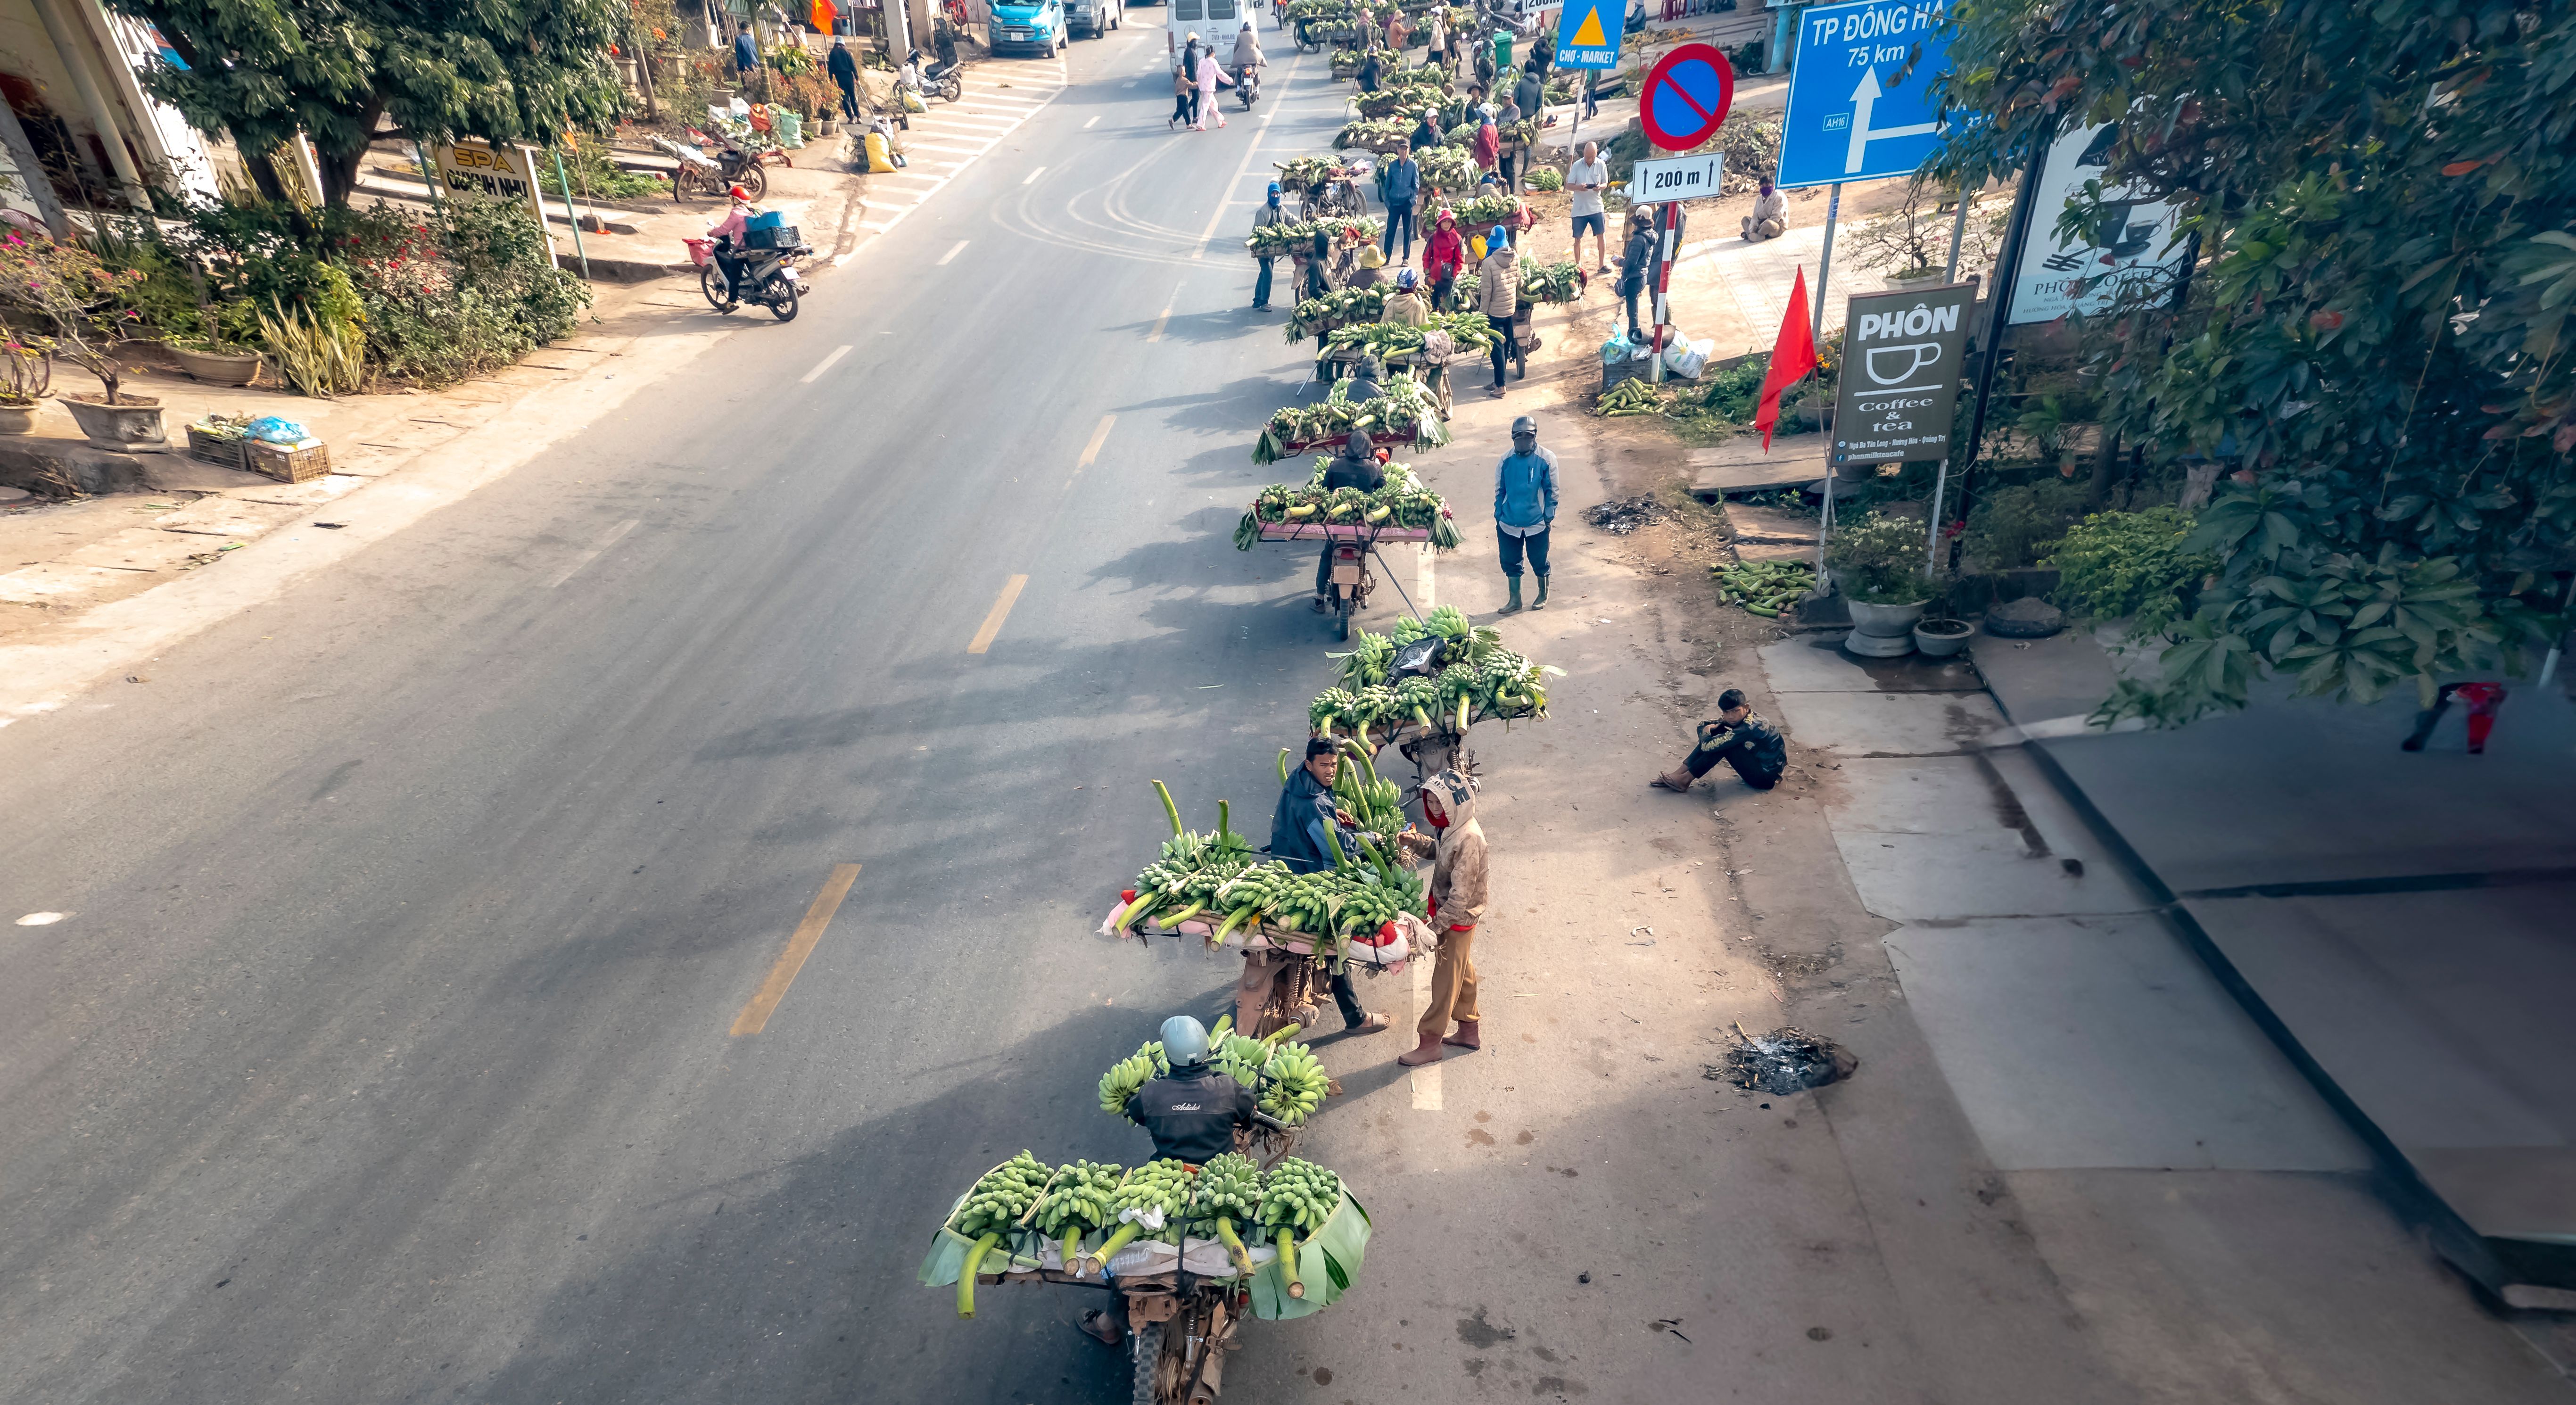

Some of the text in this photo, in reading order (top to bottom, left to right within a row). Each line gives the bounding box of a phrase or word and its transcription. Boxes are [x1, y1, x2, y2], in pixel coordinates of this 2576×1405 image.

[1812, 17, 1839, 46] TP
[1843, 4, 1908, 42] ĐÔNG
[1559, 49, 1577, 65] CHỢ
[1581, 50, 1615, 64] MARKET
[1848, 43, 1905, 67] 75 km
[1825, 117, 1845, 128] AH16
[453, 147, 517, 174] SPA
[1654, 170, 1701, 189] 200 m
[1858, 303, 1960, 341] PHÔN
[1858, 398, 1933, 412] Coffee
[1886, 411, 1901, 420] &
[1873, 420, 1913, 432] tea
[1848, 450, 1904, 462] phonmilkteacafe
